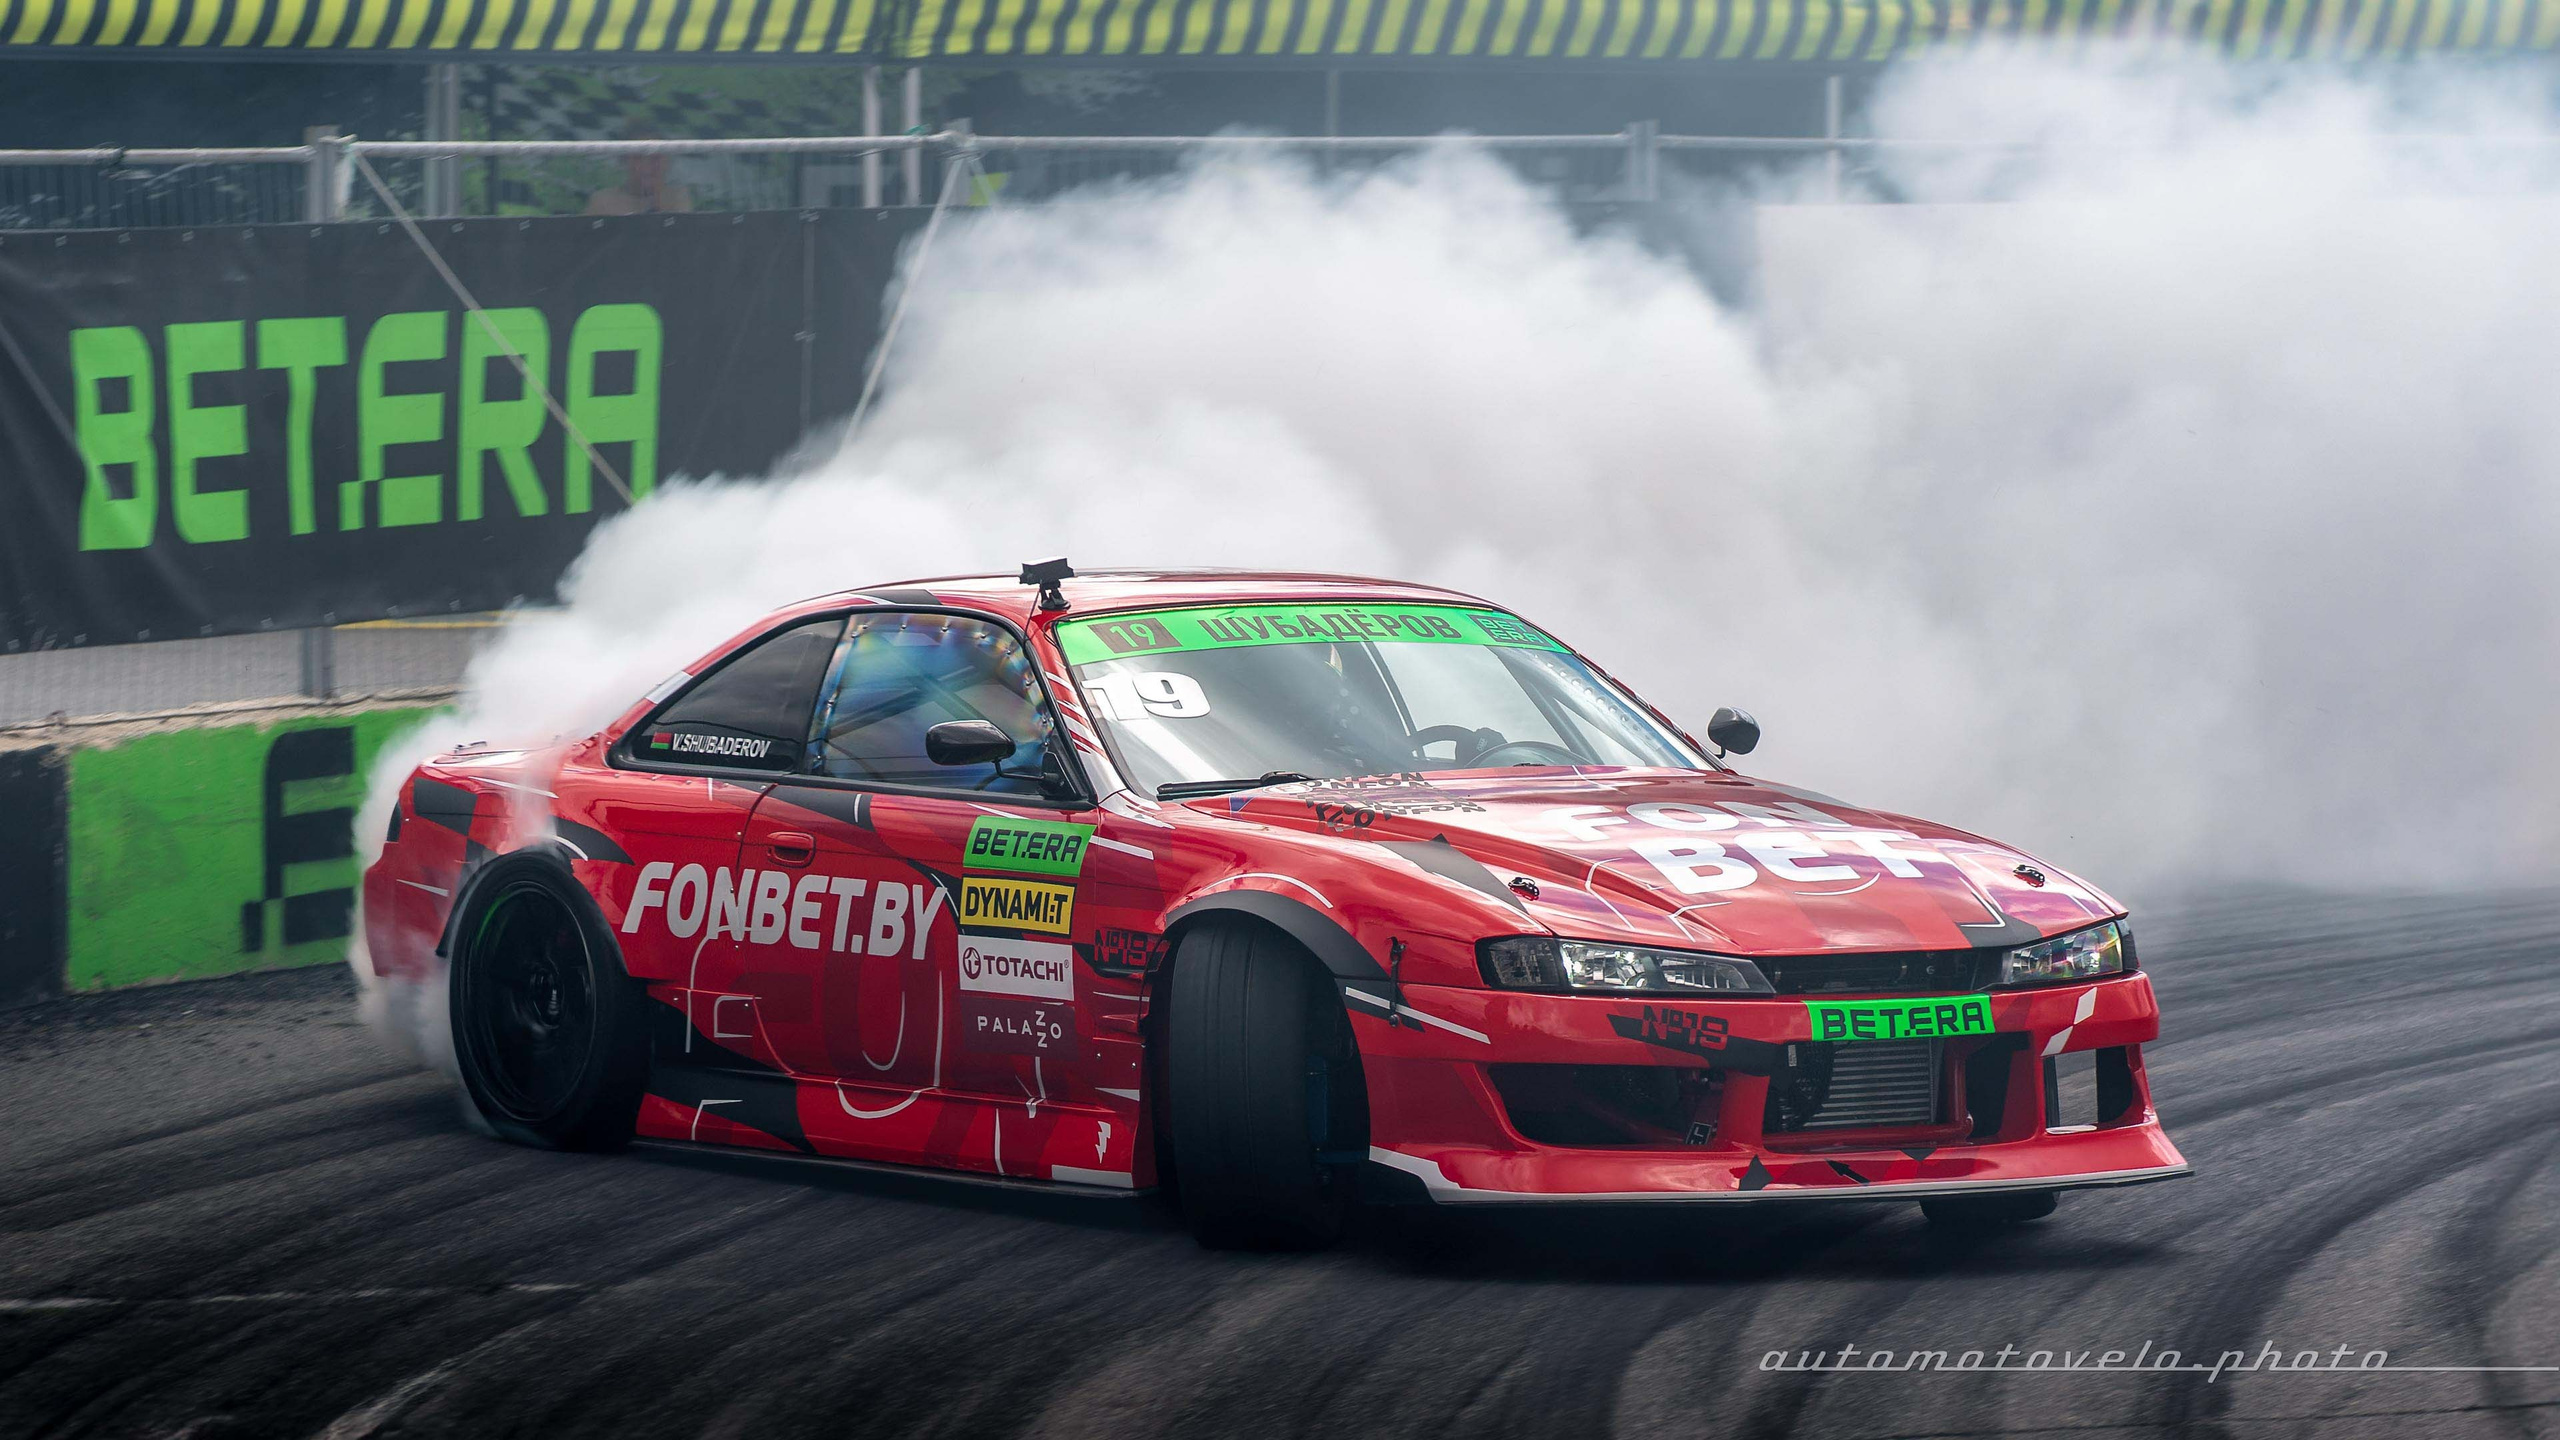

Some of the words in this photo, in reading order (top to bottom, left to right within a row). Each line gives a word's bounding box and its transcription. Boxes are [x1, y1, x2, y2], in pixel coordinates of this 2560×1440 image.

[1108, 624, 1157, 650] 19
[1197, 608, 1462, 643] ШУБАДЁРОВ
[1081, 671, 1212, 721] 19
[672, 732, 771, 758] V.SHUBADEROV
[1540, 801, 1853, 842] FON
[1628, 831, 1924, 895] BET
[621, 861, 947, 961] FONBET.BY
